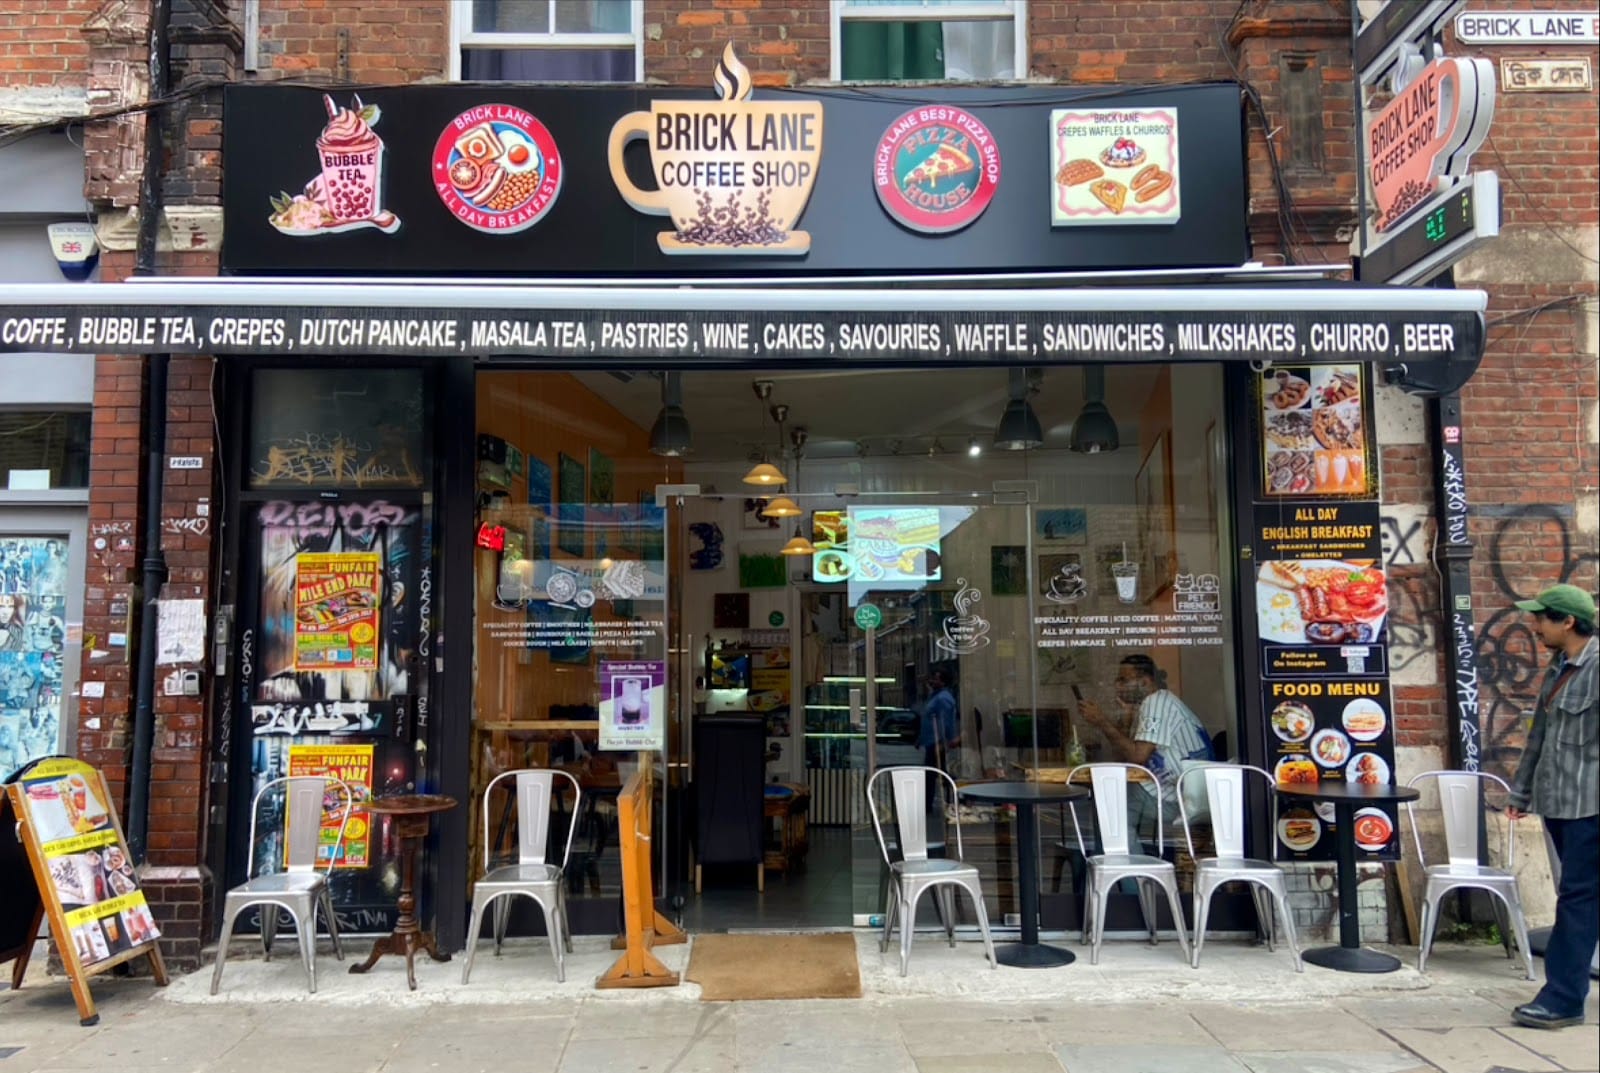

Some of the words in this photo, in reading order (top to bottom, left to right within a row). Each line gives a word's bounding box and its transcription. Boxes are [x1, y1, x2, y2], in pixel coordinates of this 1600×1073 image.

[1463, 18, 1521, 36] BRICK
[1530, 18, 1584, 36] LANE
[453, 106, 494, 130] BRICK
[497, 106, 533, 129] LANE
[1371, 108, 1404, 159] BRICK
[1404, 73, 1436, 128] LANE
[657, 113, 737, 151] BRICK
[746, 113, 816, 151] LANE
[1058, 126, 1087, 137] CREPES
[1089, 125, 1124, 136] WAFFLES
[1125, 125, 1132, 136] &
[877, 152, 890, 186] BRICK
[887, 118, 918, 147] LANE
[920, 109, 955, 121] BEST
[957, 114, 987, 145] PIZZA
[983, 143, 998, 185] SHOP
[902, 127, 970, 156] PIZZA
[1373, 139, 1406, 187] COFFEE
[1407, 117, 1435, 157] SHOP
[325, 154, 375, 168] BUBBLE
[338, 169, 363, 181] TEA
[661, 160, 745, 188] COFFEE
[752, 161, 811, 188] SHOP
[437, 181, 456, 209] ALL
[458, 205, 485, 227] DAY
[488, 175, 556, 228] BREAKFAST
[905, 181, 971, 208] HOUSE
[78, 317, 156, 345] BUBBLE
[300, 318, 364, 347] DUTCH
[471, 319, 547, 348] MASALA
[1404, 323, 1455, 352] BEER
[1296, 508, 1316, 521] ALL
[1317, 507, 1338, 520] DAY
[1262, 527, 1309, 540] ENGLISH
[1311, 525, 1373, 539] BREAKFAST
[329, 562, 375, 573] FUNFAIR
[299, 584, 325, 602] MILE
[324, 576, 346, 596] END
[346, 573, 375, 589] PARK
[1187, 594, 1205, 602] PET
[1178, 602, 1215, 610] FRIENDLY
[1075, 627, 1120, 635] BREAKFAST
[1286, 660, 1327, 668] Instagram
[1272, 683, 1322, 696] FOOD
[1327, 683, 1381, 696] MENU
[322, 756, 369, 766] FUNFAIR
[340, 767, 368, 782] PARK
